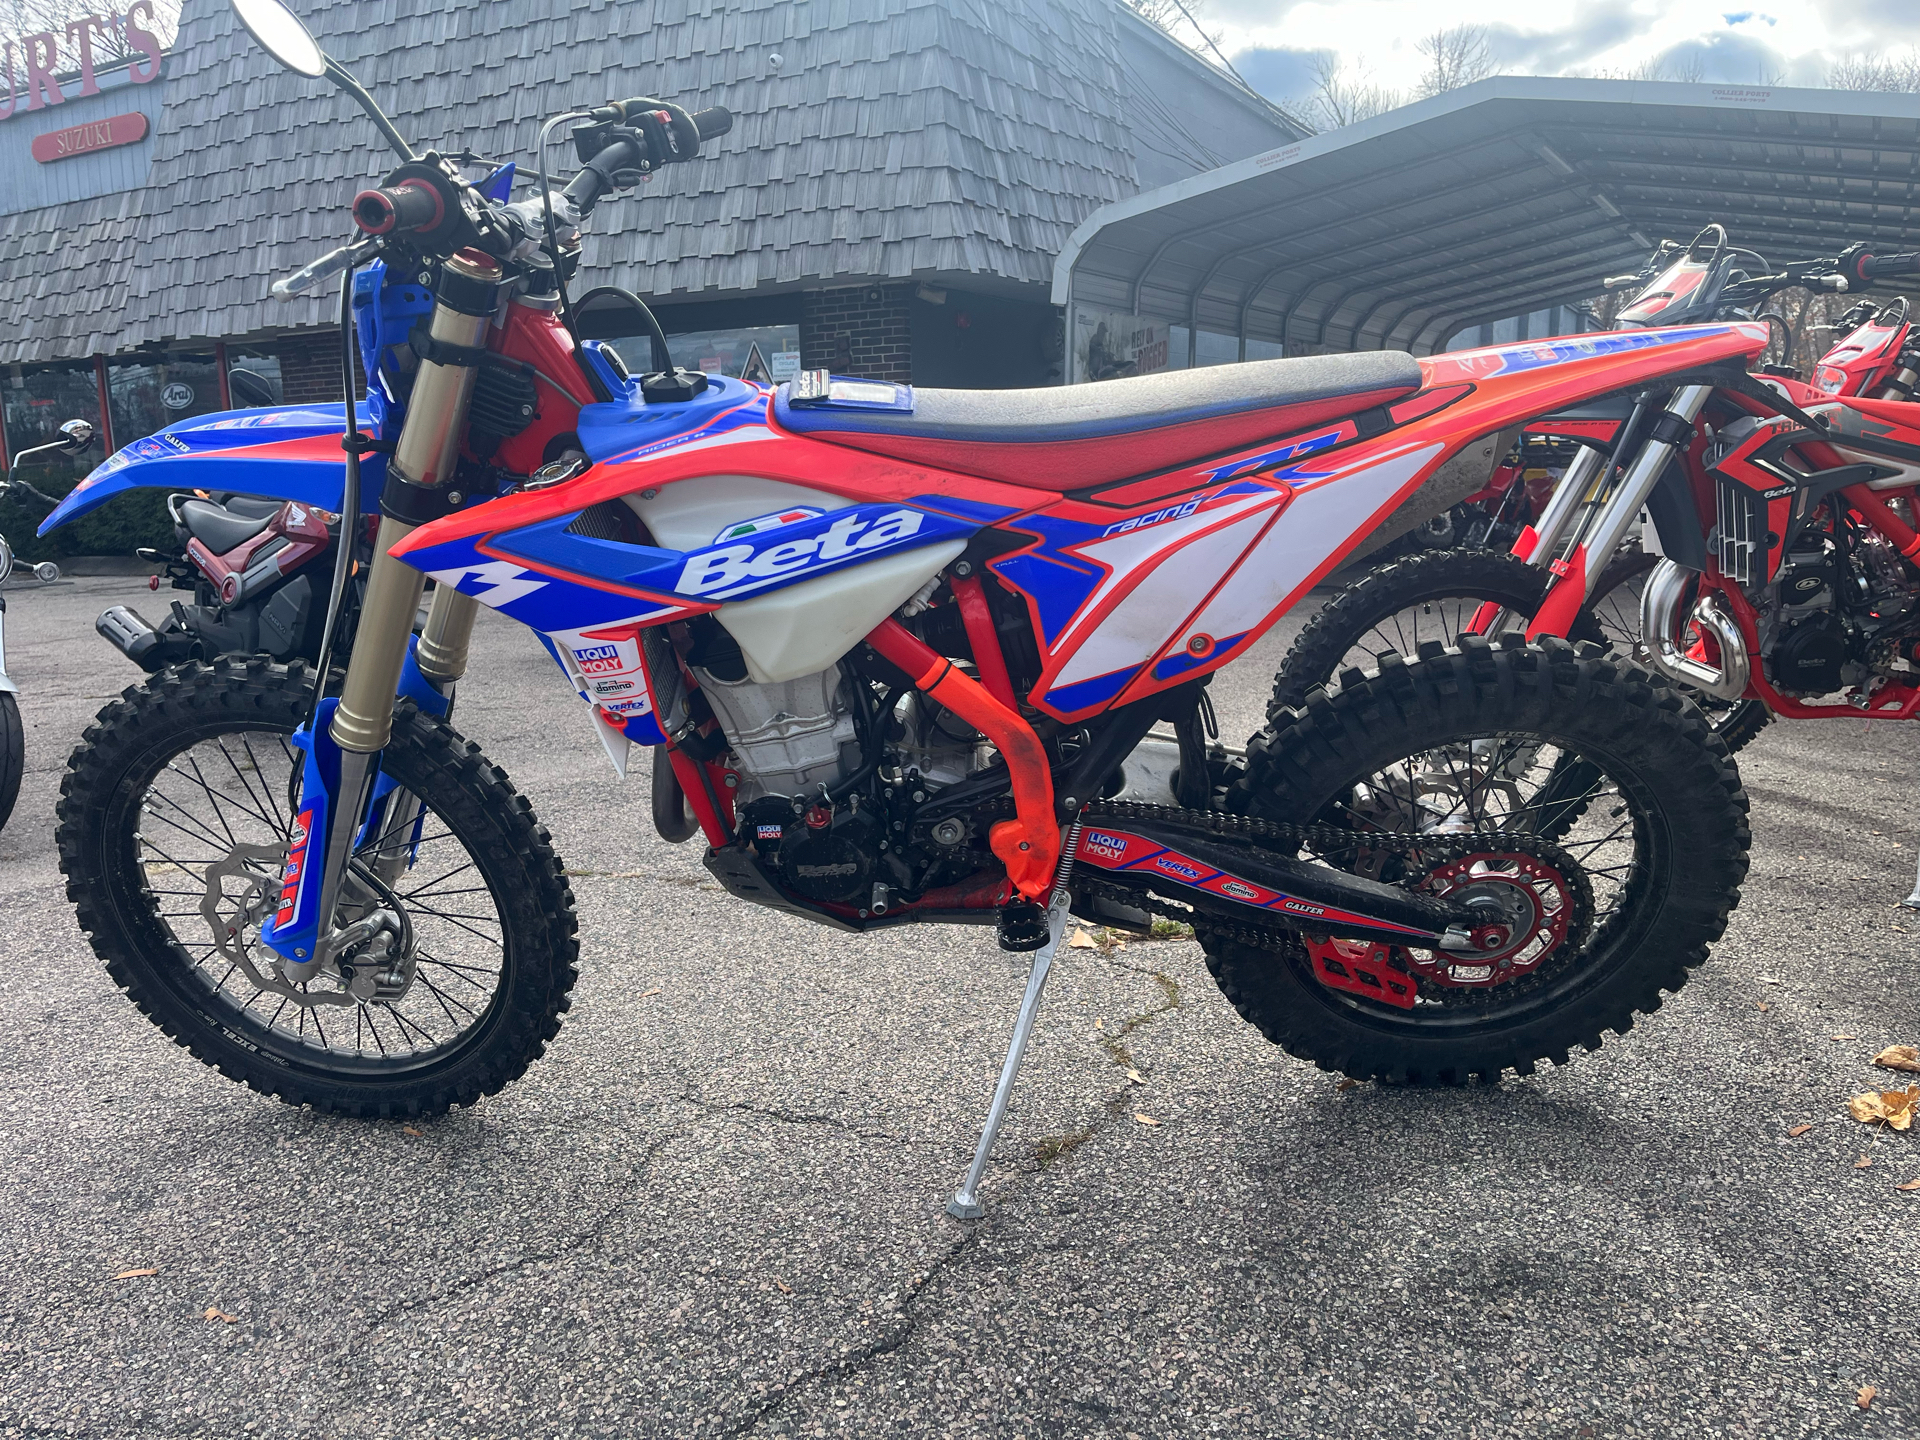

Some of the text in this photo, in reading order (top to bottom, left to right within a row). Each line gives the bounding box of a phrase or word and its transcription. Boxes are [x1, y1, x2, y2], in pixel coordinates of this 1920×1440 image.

[56, 121, 113, 154] SUZUKI
[798, 371, 811, 398] Beta
[164, 433, 191, 453] GALFER
[1763, 486, 1797, 498] Beta
[1101, 496, 1204, 539] racing
[673, 509, 925, 597] Beta
[574, 646, 617, 661] LIQUI
[580, 658, 619, 672] MOLY
[595, 680, 633, 692] domino
[607, 700, 645, 711] VERTEX
[1495, 731, 1541, 739] EXCEL
[1089, 833, 1125, 850] LIQUI
[1086, 843, 1122, 858] MOLY
[1157, 857, 1200, 878] VERTEX
[1225, 882, 1255, 898] domino
[1285, 901, 1324, 915] GALFER
[222, 1026, 259, 1052] EXCEL
